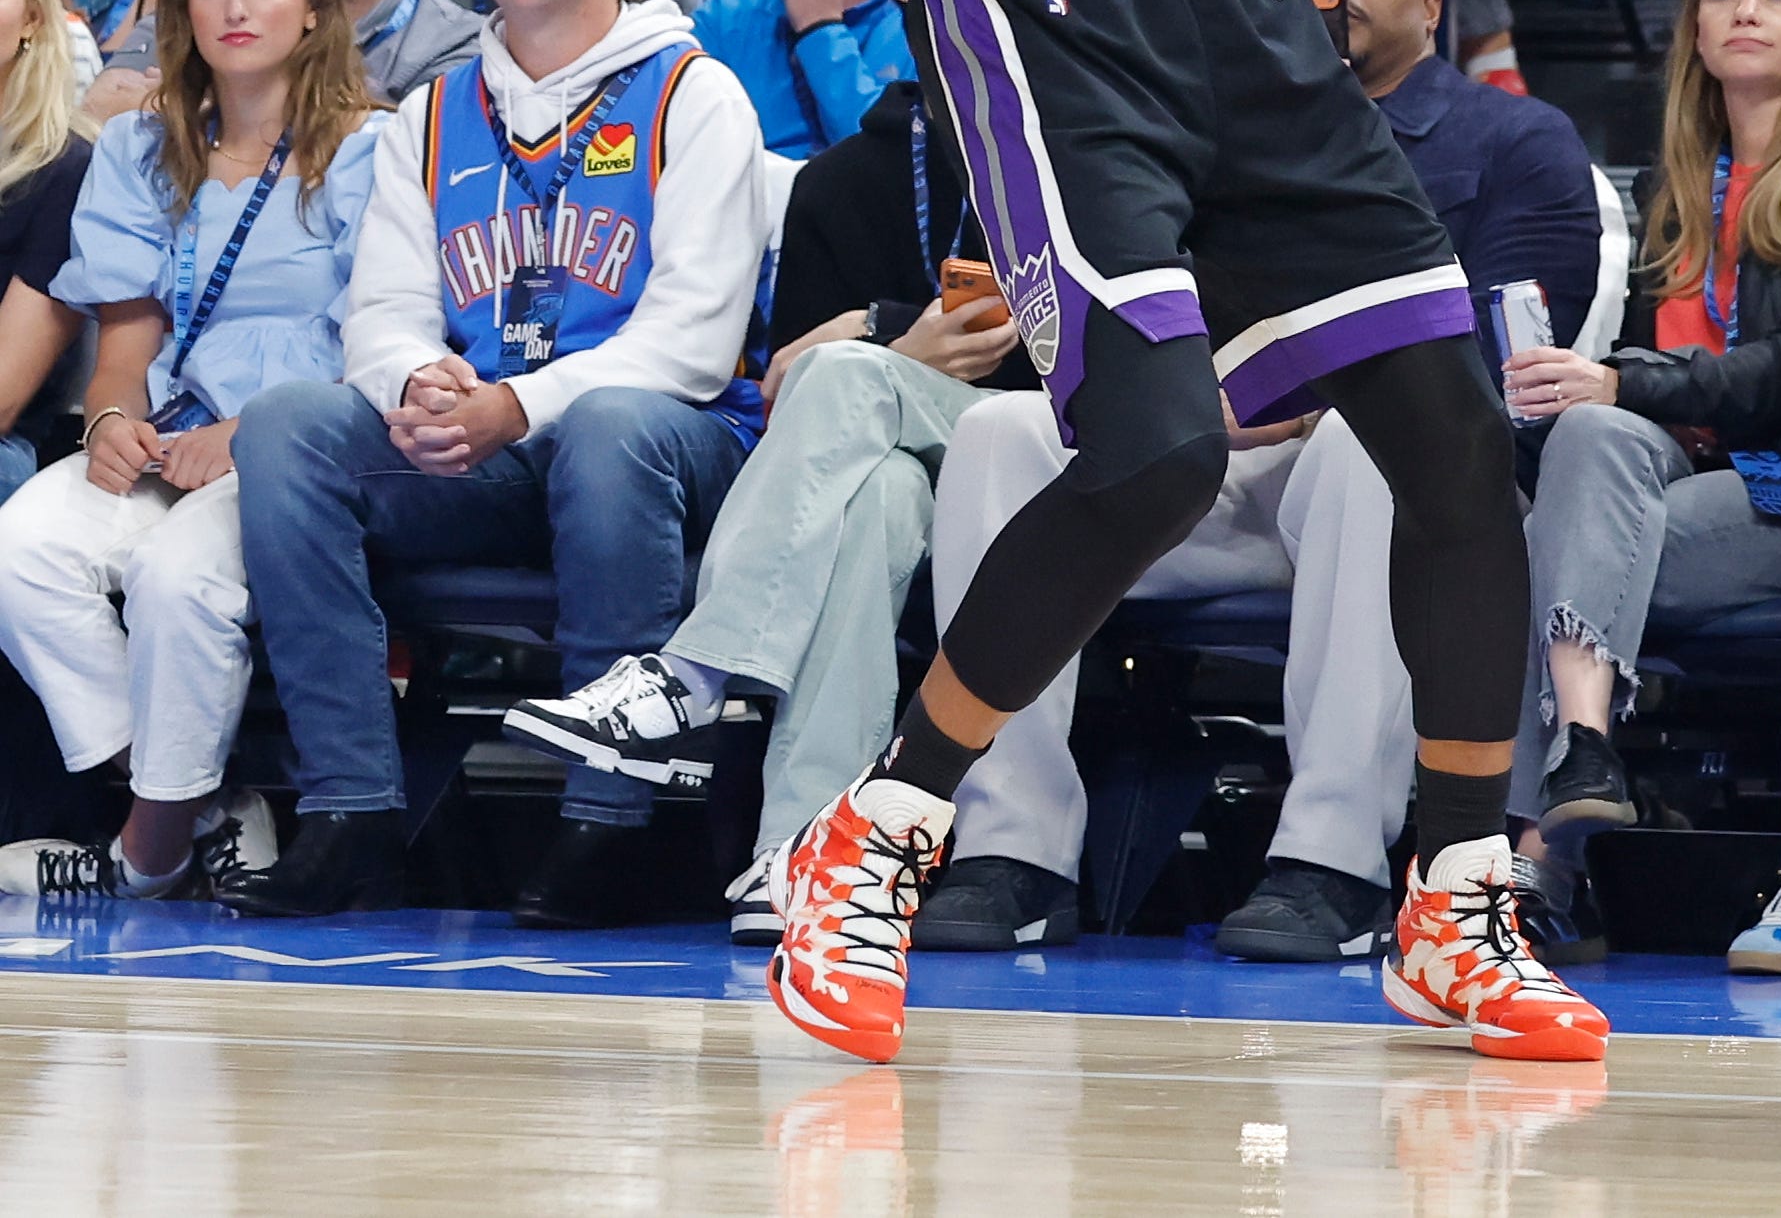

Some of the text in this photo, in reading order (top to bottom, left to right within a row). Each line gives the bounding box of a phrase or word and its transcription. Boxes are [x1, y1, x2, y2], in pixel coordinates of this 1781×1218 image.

[240, 181, 272, 228] CITY
[503, 323, 545, 343] GAME
[523, 339, 553, 360] DAY
